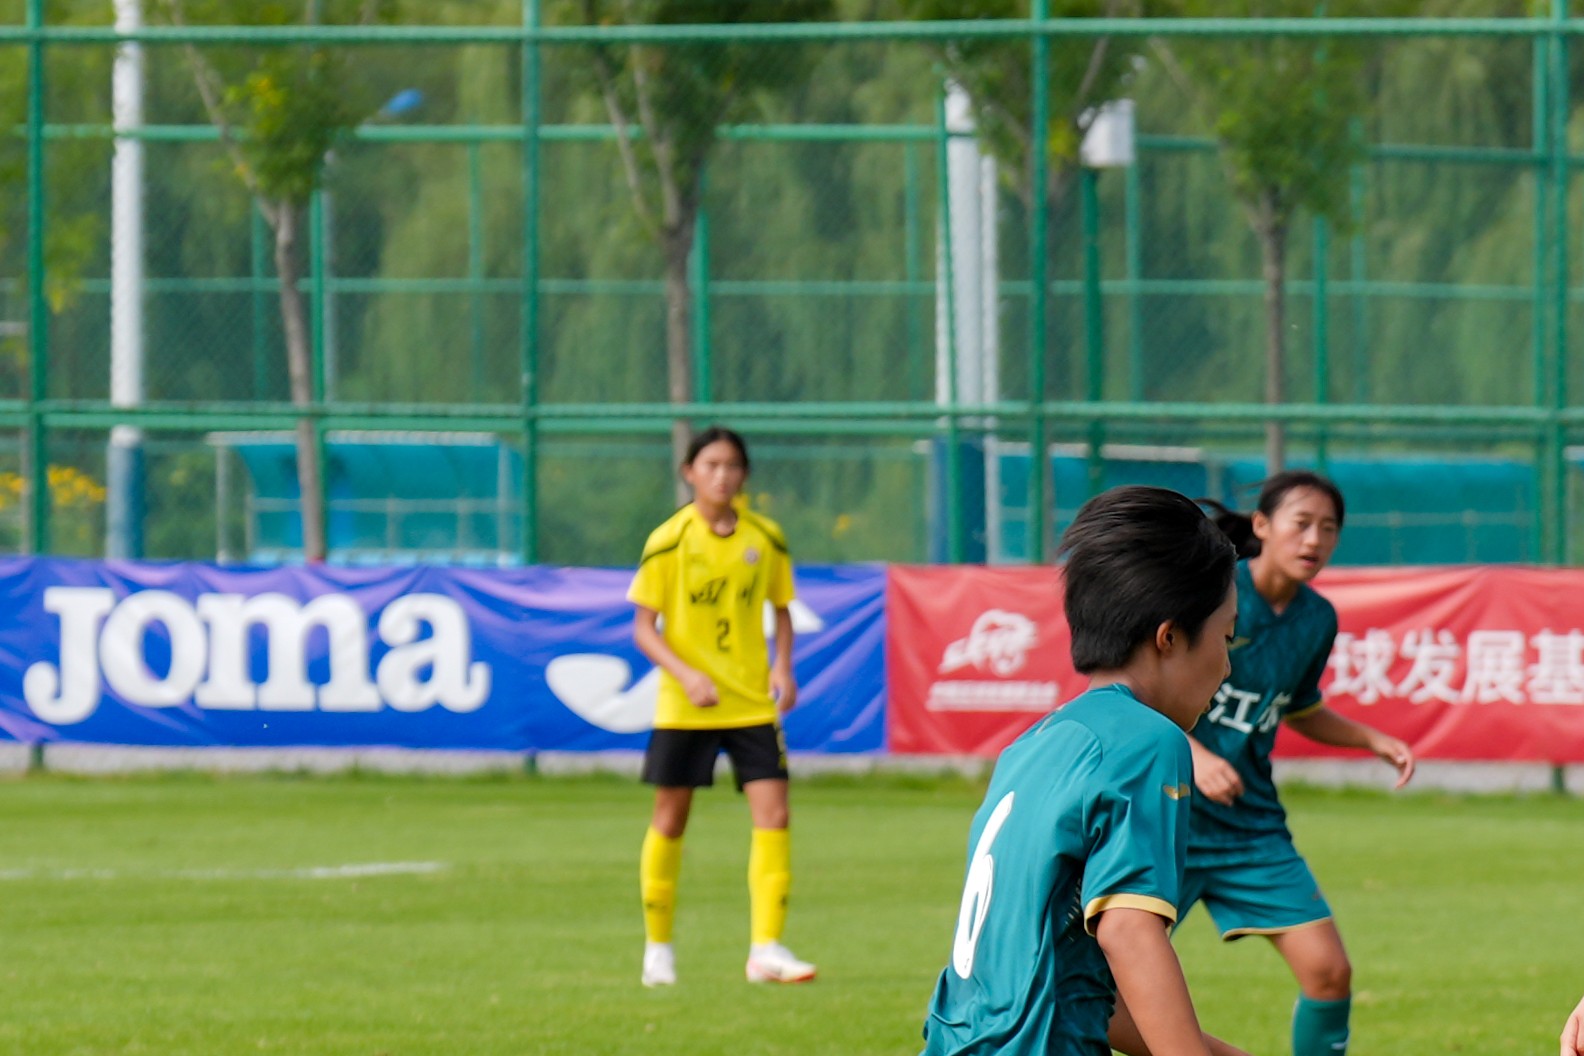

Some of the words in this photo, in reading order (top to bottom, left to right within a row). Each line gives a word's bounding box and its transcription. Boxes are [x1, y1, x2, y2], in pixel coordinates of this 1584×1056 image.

[23, 586, 491, 725] Joma
[716, 617, 731, 653] 2
[953, 790, 1015, 979] 6
